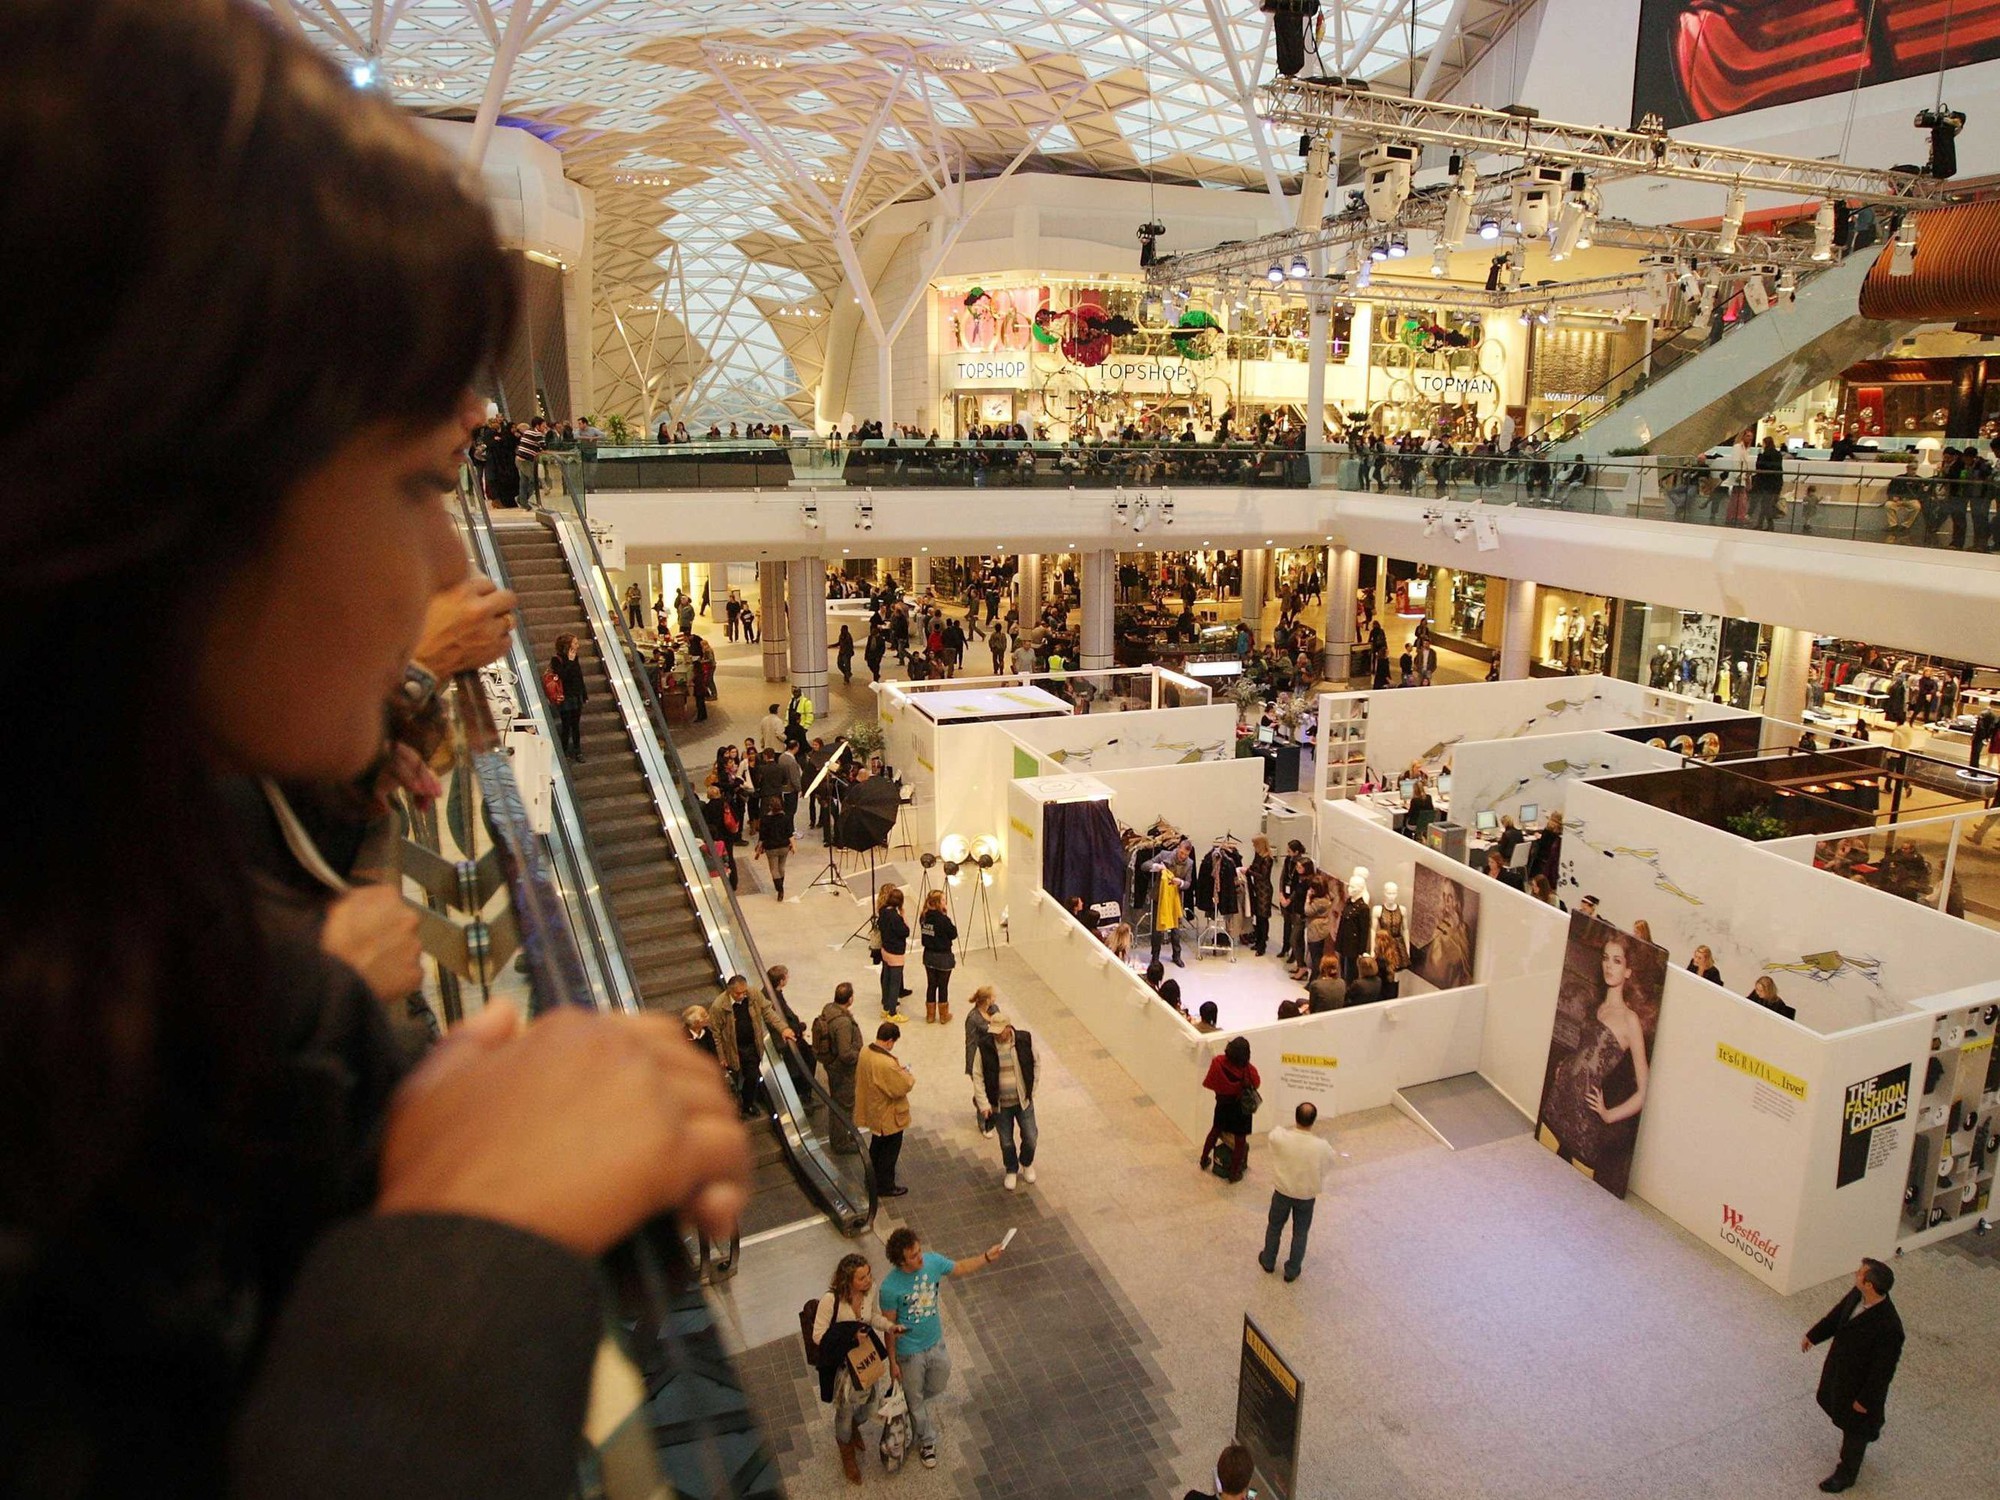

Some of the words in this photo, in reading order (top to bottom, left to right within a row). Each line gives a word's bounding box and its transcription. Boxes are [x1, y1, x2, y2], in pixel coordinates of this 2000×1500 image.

[957, 361, 1025, 379] TOPSHOP
[1099, 363, 1187, 381] TOPSHOP
[1421, 376, 1494, 393] TOPMAN
[1718, 1047, 1735, 1064] It's
[1781, 1076, 1804, 1098] live!
[1845, 1080, 1907, 1120] FASHION
[1848, 1077, 1879, 1102] THE
[1850, 1095, 1907, 1130] CHARTS
[1722, 1203, 1781, 1258] Westfield
[1931, 1209, 1942, 1222] 10
[1720, 1227, 1774, 1271] LONDON
